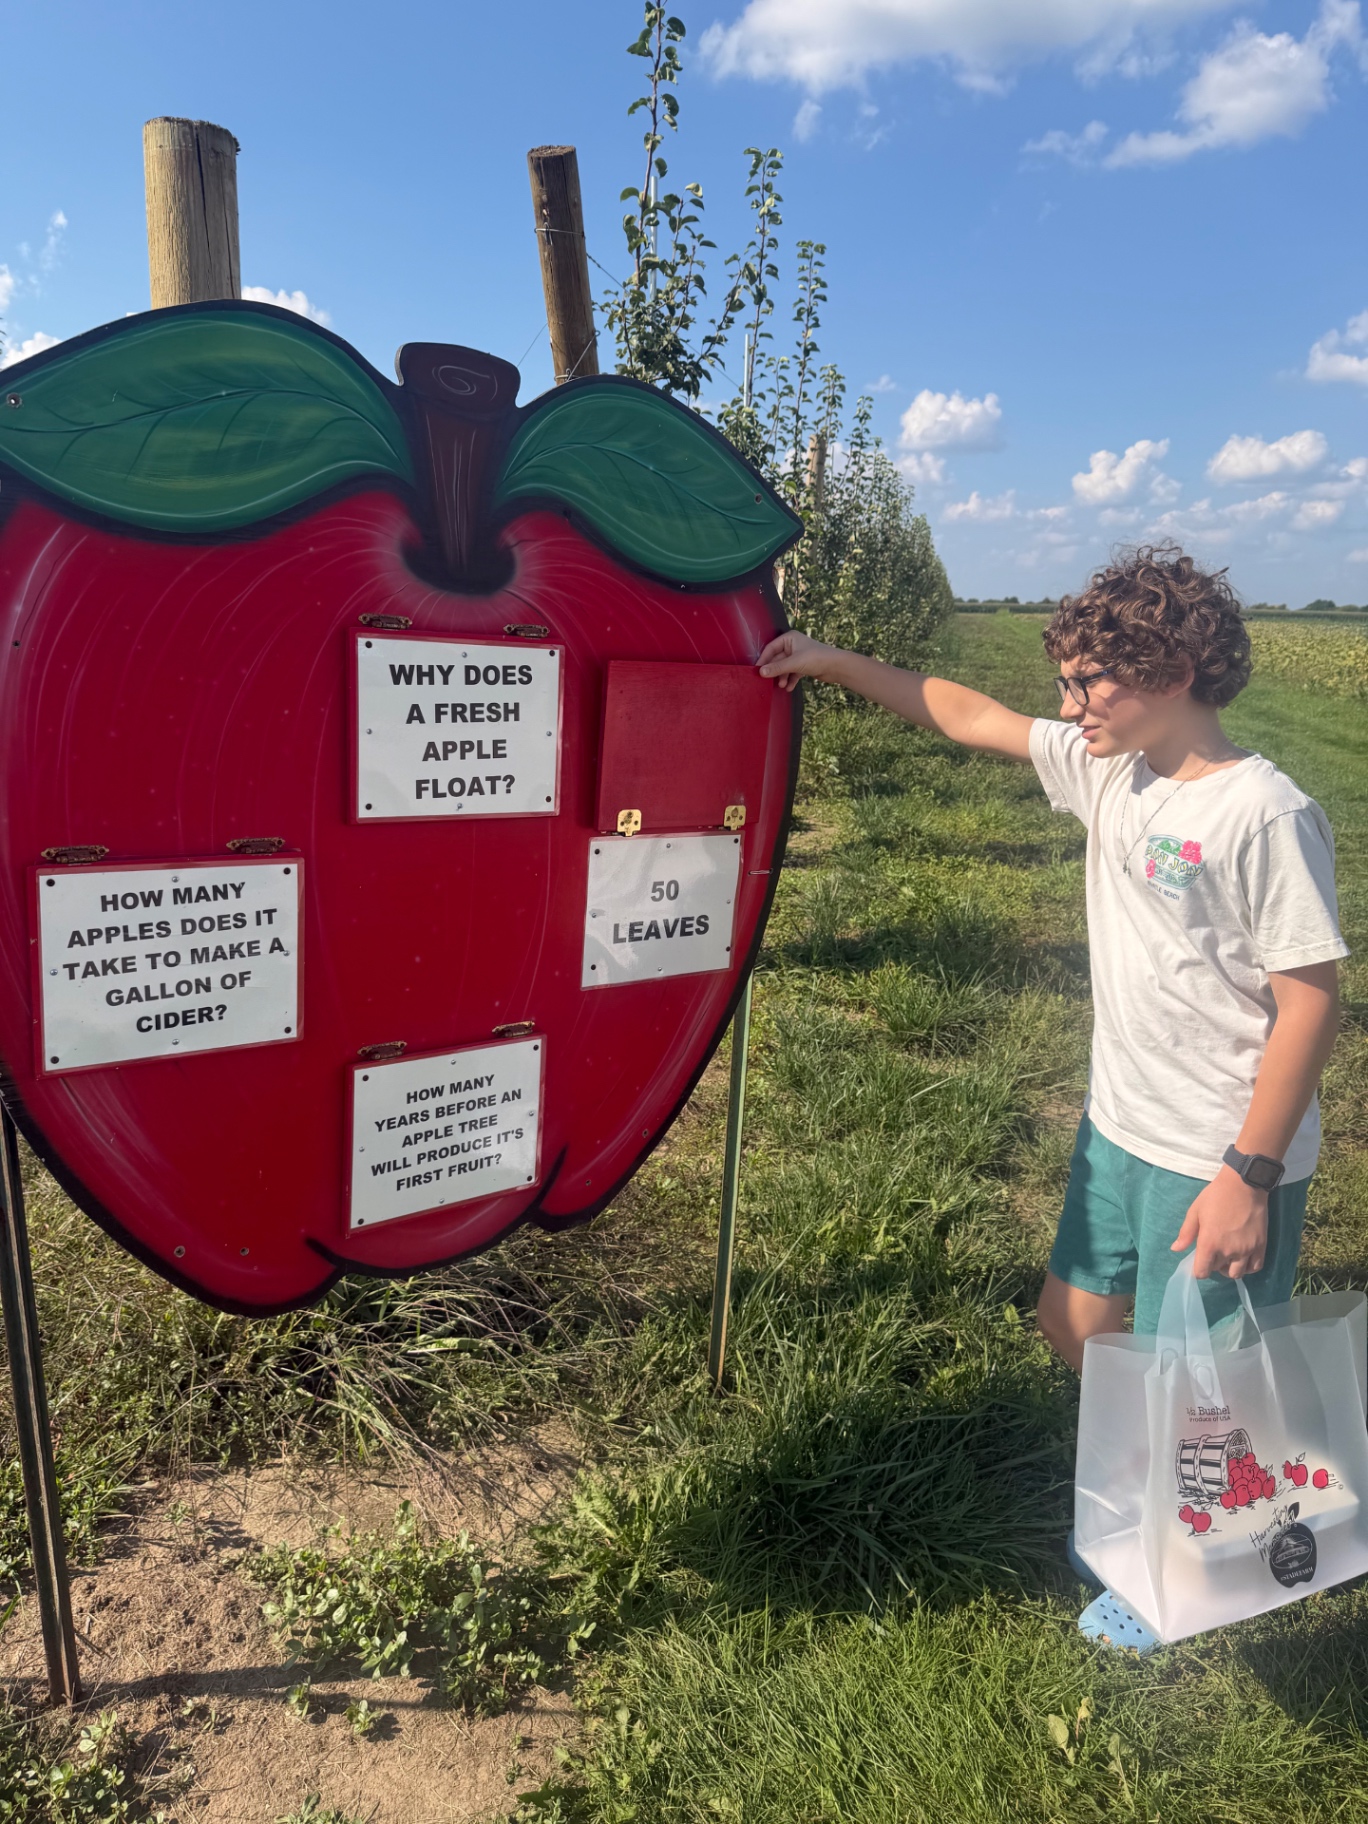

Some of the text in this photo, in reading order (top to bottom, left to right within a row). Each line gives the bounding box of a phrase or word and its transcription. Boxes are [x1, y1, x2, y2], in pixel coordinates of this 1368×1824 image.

[389, 664, 533, 686] WHY DOES
[405, 702, 520, 724] A FRESH
[422, 739, 508, 762] APPLE
[415, 774, 516, 800] FLOAT?
[100, 882, 246, 912] HOW MANY
[650, 879, 680, 902] 50
[67, 908, 278, 948] APPLES DOES IT
[612, 914, 710, 944] LEAVES
[63, 937, 285, 980] TAKE TO MAKE A
[105, 971, 252, 1007] GALLON OF
[136, 1004, 227, 1033] CIDER?
[406, 1074, 495, 1104] HOW MANY
[374, 1088, 522, 1132] YEARS BEFORE AN
[401, 1114, 498, 1148] APPLE TREE
[371, 1128, 524, 1177] WILL PRODUCE IT'S
[396, 1153, 502, 1191] FIRST FRUIT?
[1197, 1405, 1231, 1416] Bushel
